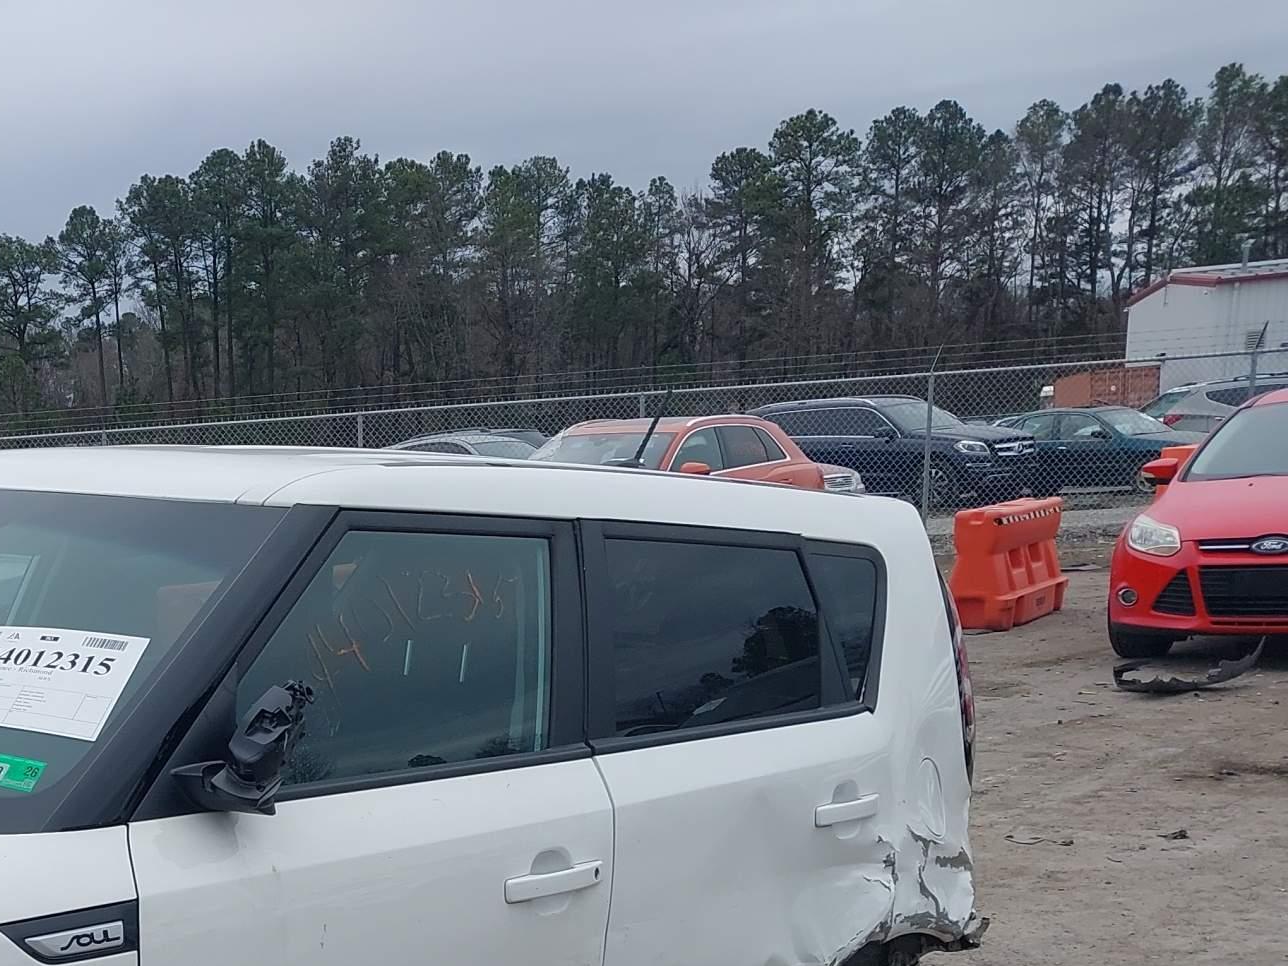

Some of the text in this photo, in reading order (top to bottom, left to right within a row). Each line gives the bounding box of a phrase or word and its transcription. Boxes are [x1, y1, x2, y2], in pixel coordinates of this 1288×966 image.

[17, 666, 54, 676] Richmond
[24, 765, 40, 778] 26
[60, 930, 120, 952] SOUL
